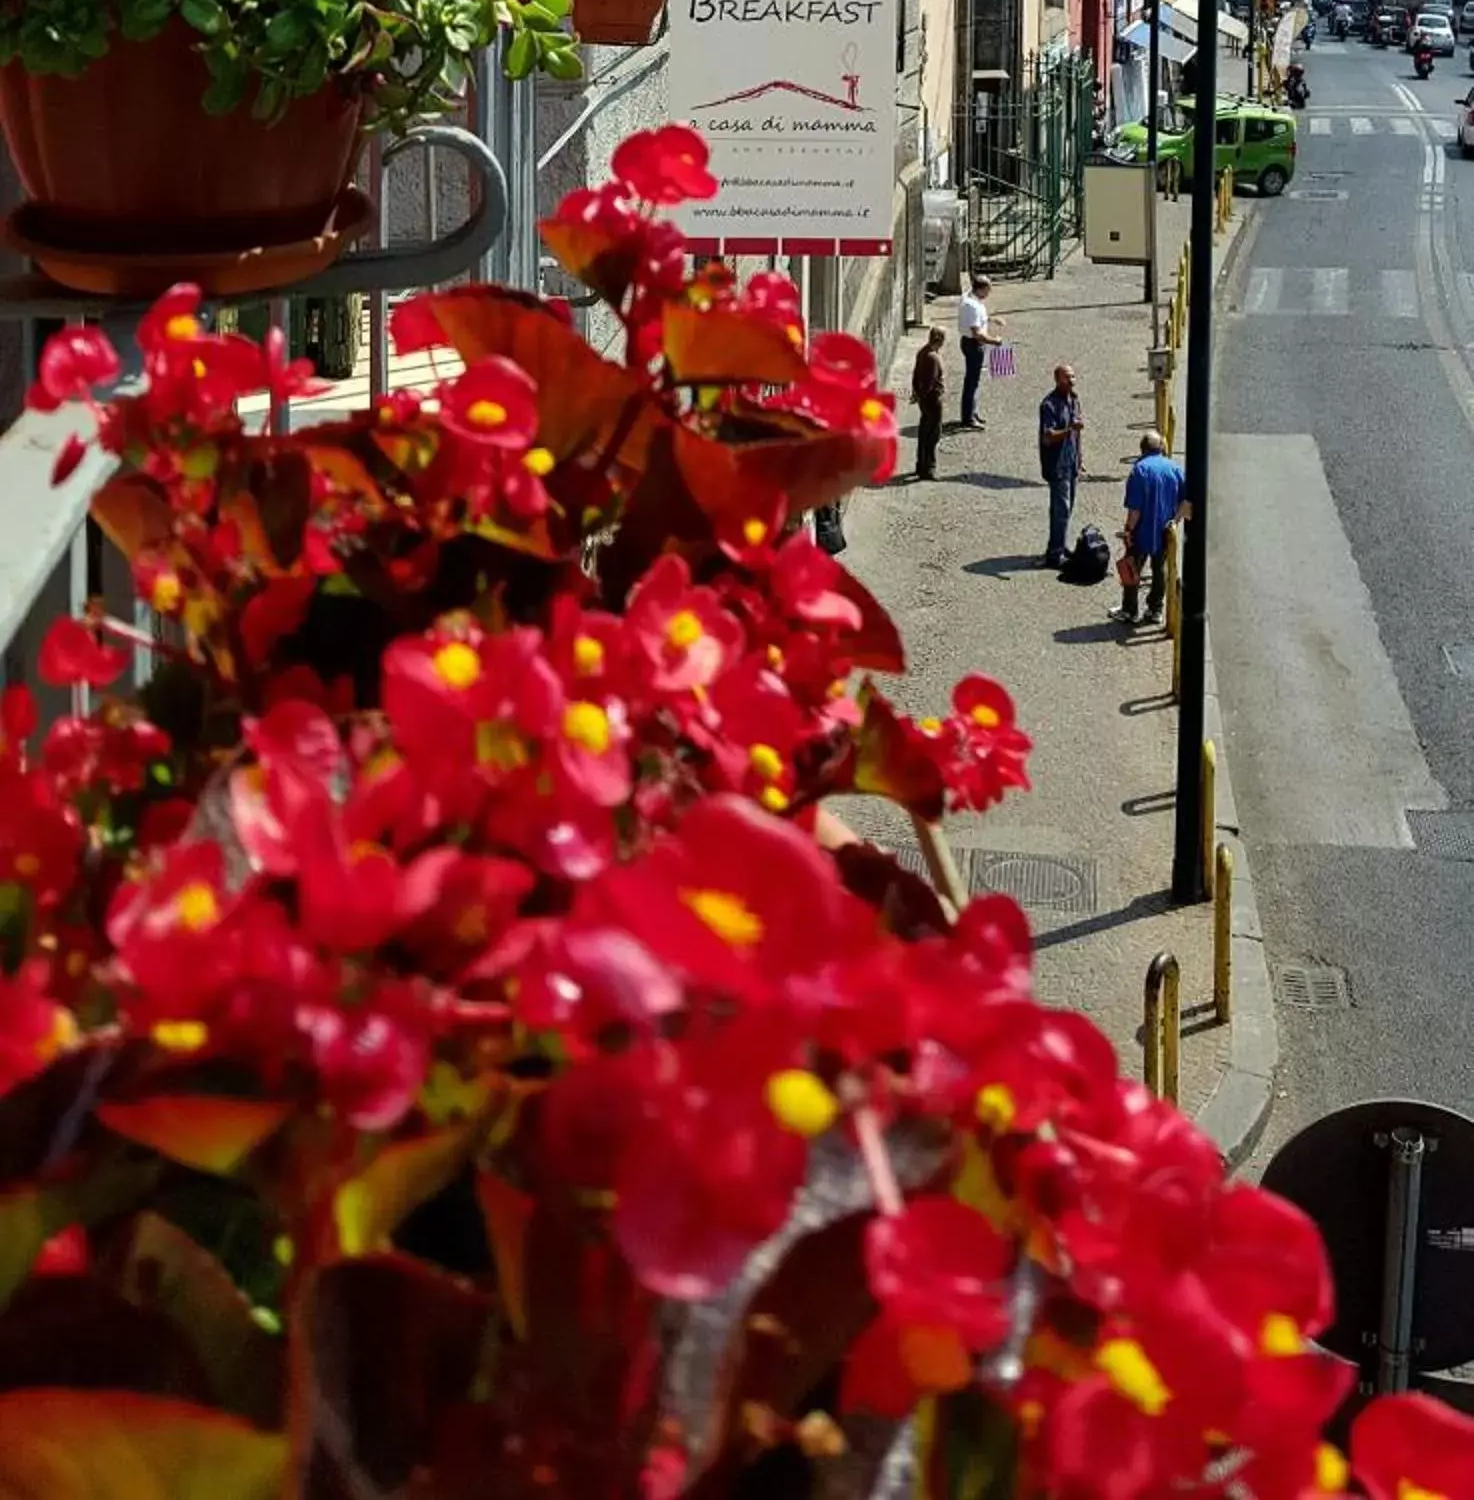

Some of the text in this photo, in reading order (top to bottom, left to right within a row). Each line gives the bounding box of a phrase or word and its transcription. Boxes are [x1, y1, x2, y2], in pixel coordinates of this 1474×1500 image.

[708, 118, 753, 133] casa
[761, 115, 785, 133] di
[792, 118, 877, 133] mamma
